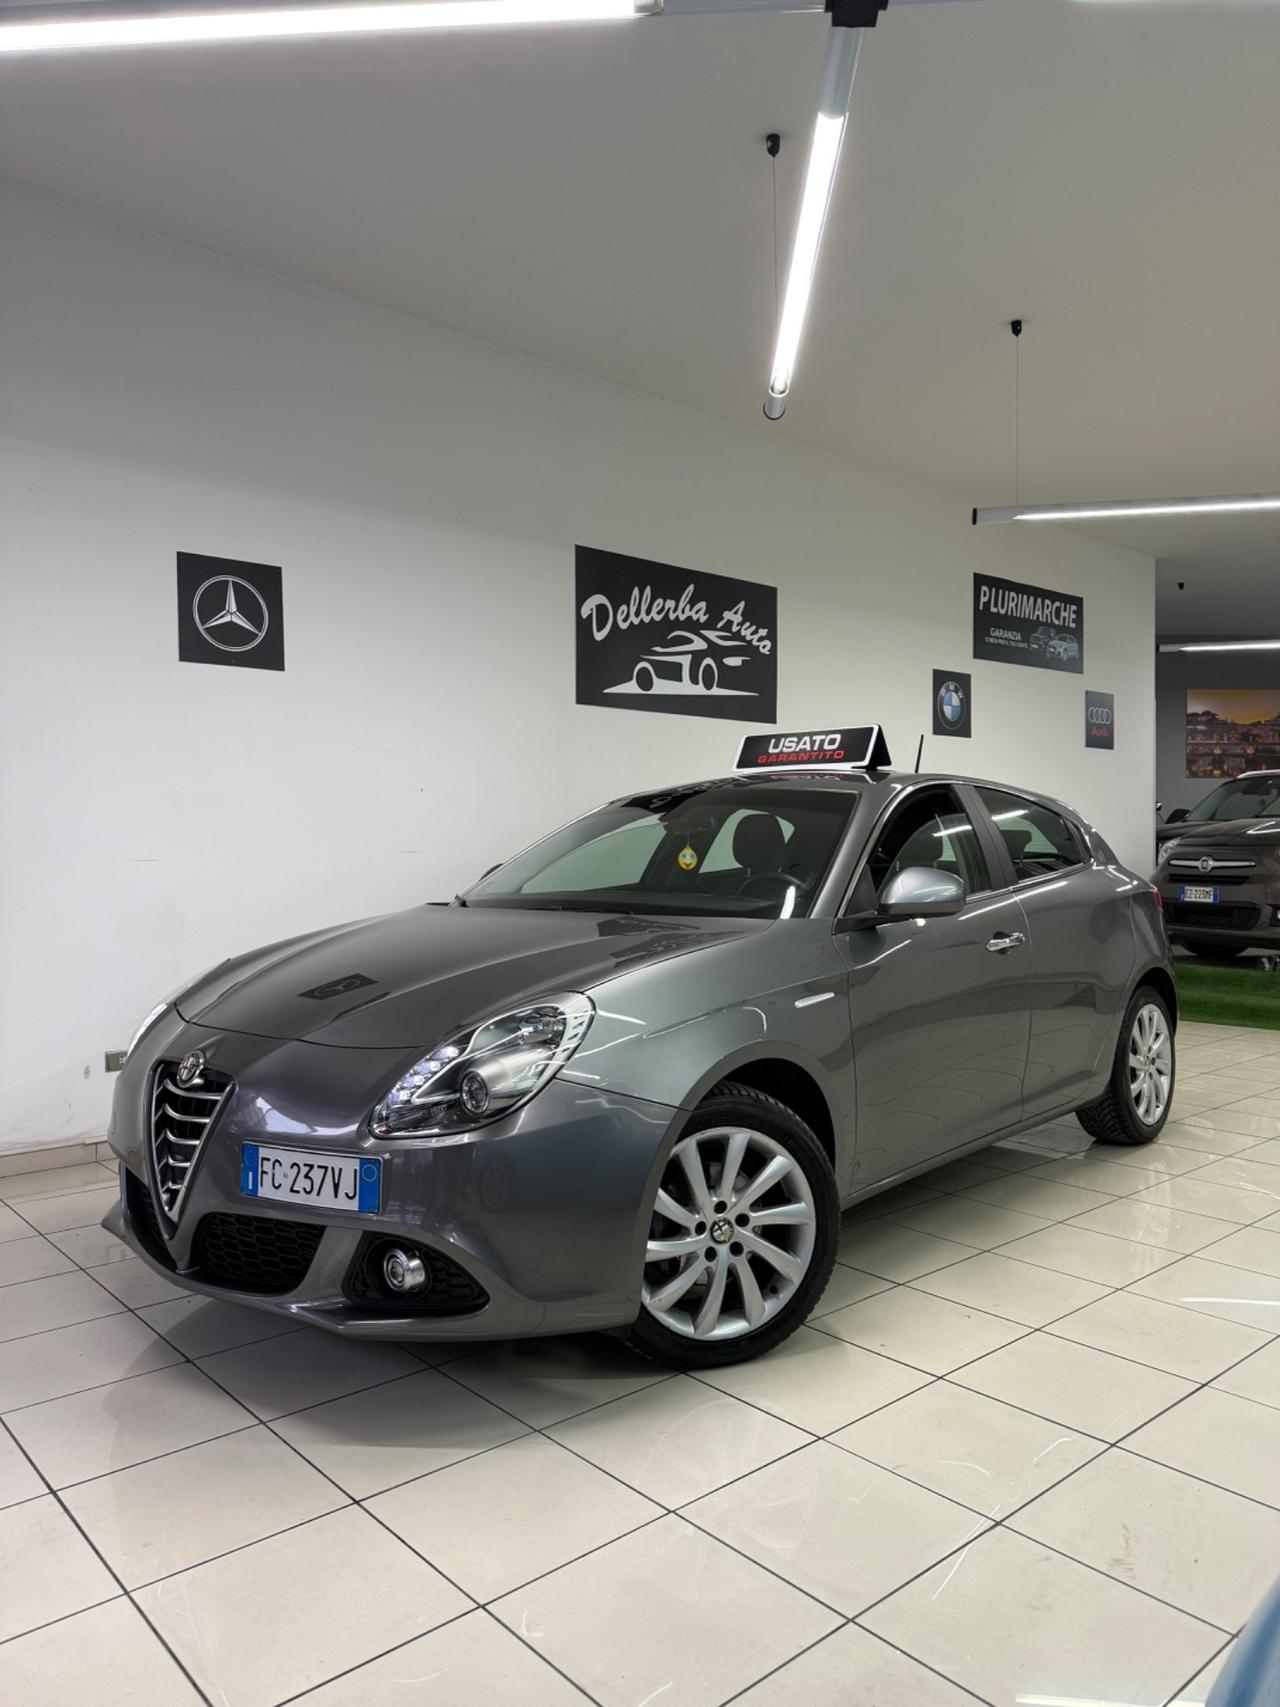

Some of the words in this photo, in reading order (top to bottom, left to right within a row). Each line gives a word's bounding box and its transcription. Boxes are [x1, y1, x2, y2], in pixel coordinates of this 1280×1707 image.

[581, 583, 709, 641] Dellerba
[717, 600, 772, 655] Auto
[979, 585, 1078, 628] PLURIMARCHE
[757, 750, 845, 763] GARANTITO
[768, 734, 842, 753] USATO
